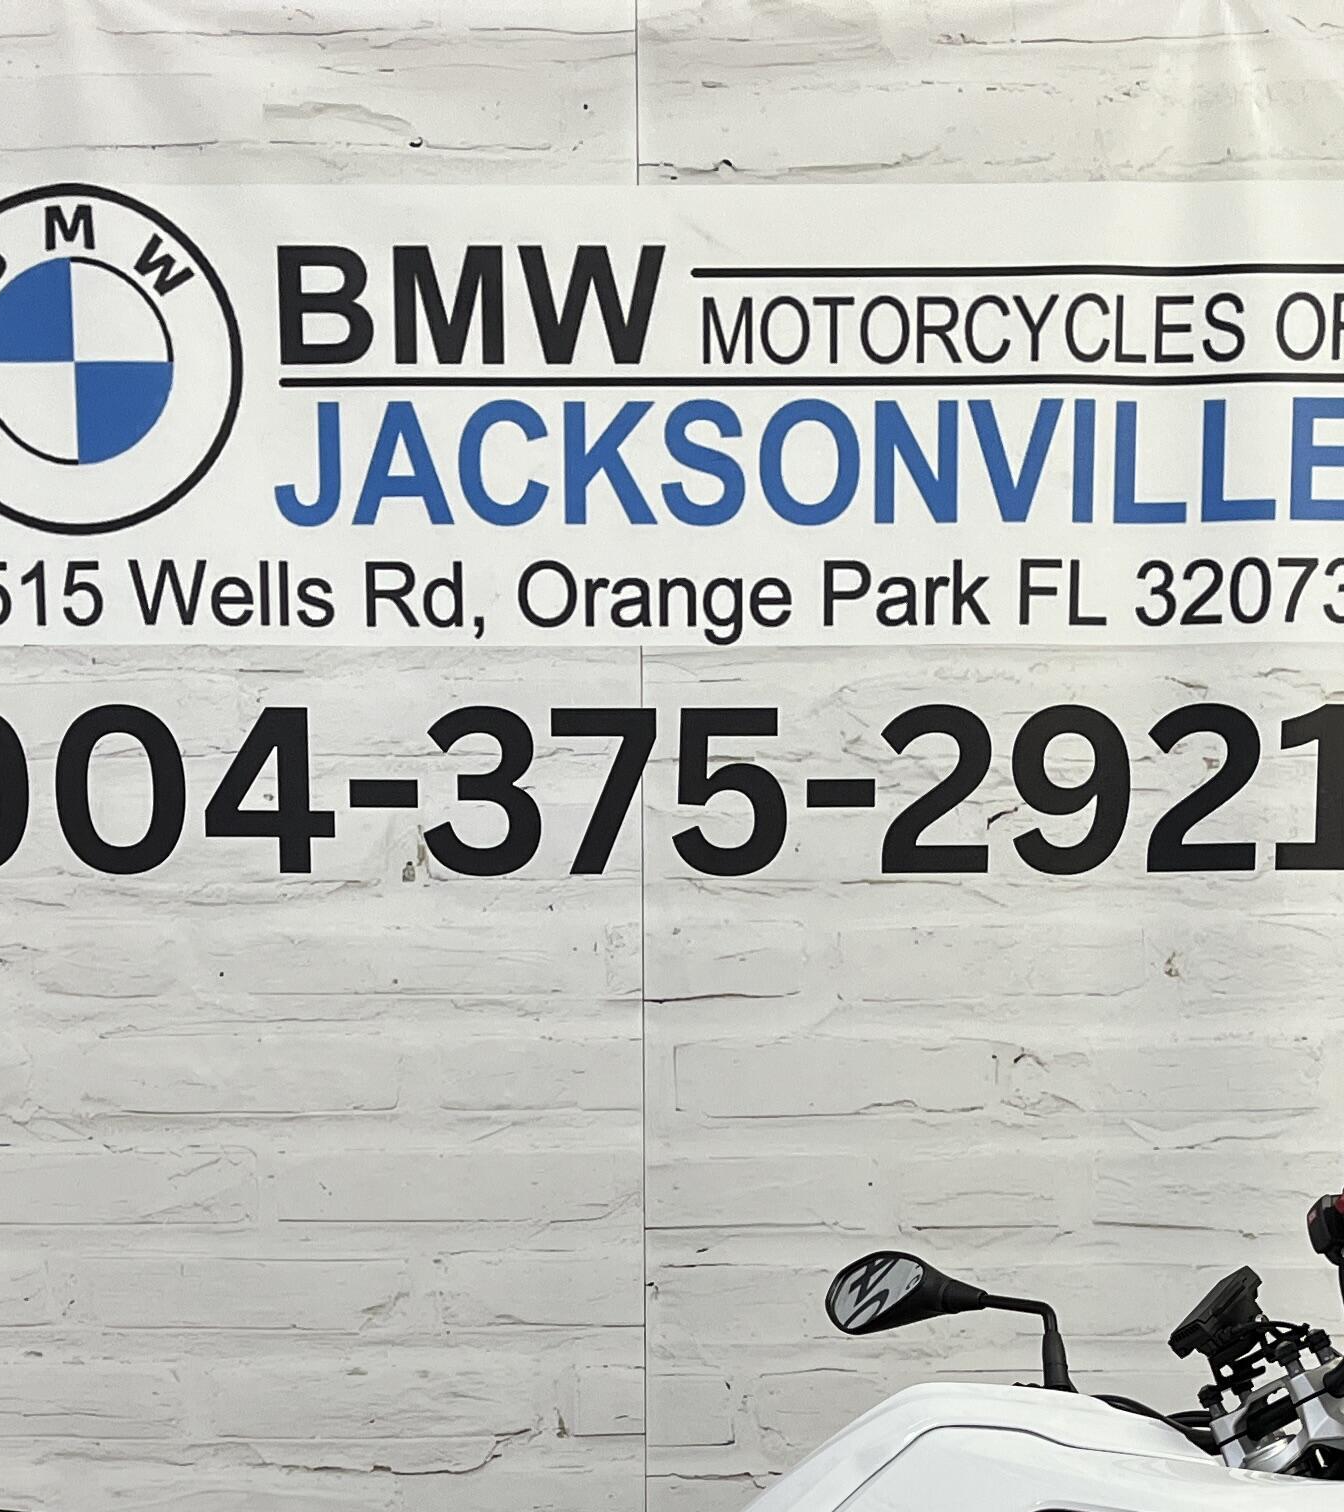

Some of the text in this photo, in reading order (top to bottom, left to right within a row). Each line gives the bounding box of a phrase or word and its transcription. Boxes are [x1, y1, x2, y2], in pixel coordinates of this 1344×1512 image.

[277, 246, 665, 365] BMW
[703, 293, 1244, 365] MOTORCYCLES
[128, 560, 334, 627] Wells
[366, 561, 484, 639] Rd,
[518, 560, 791, 646] Orange
[824, 560, 990, 627] Park
[1020, 559, 1106, 626] FL
